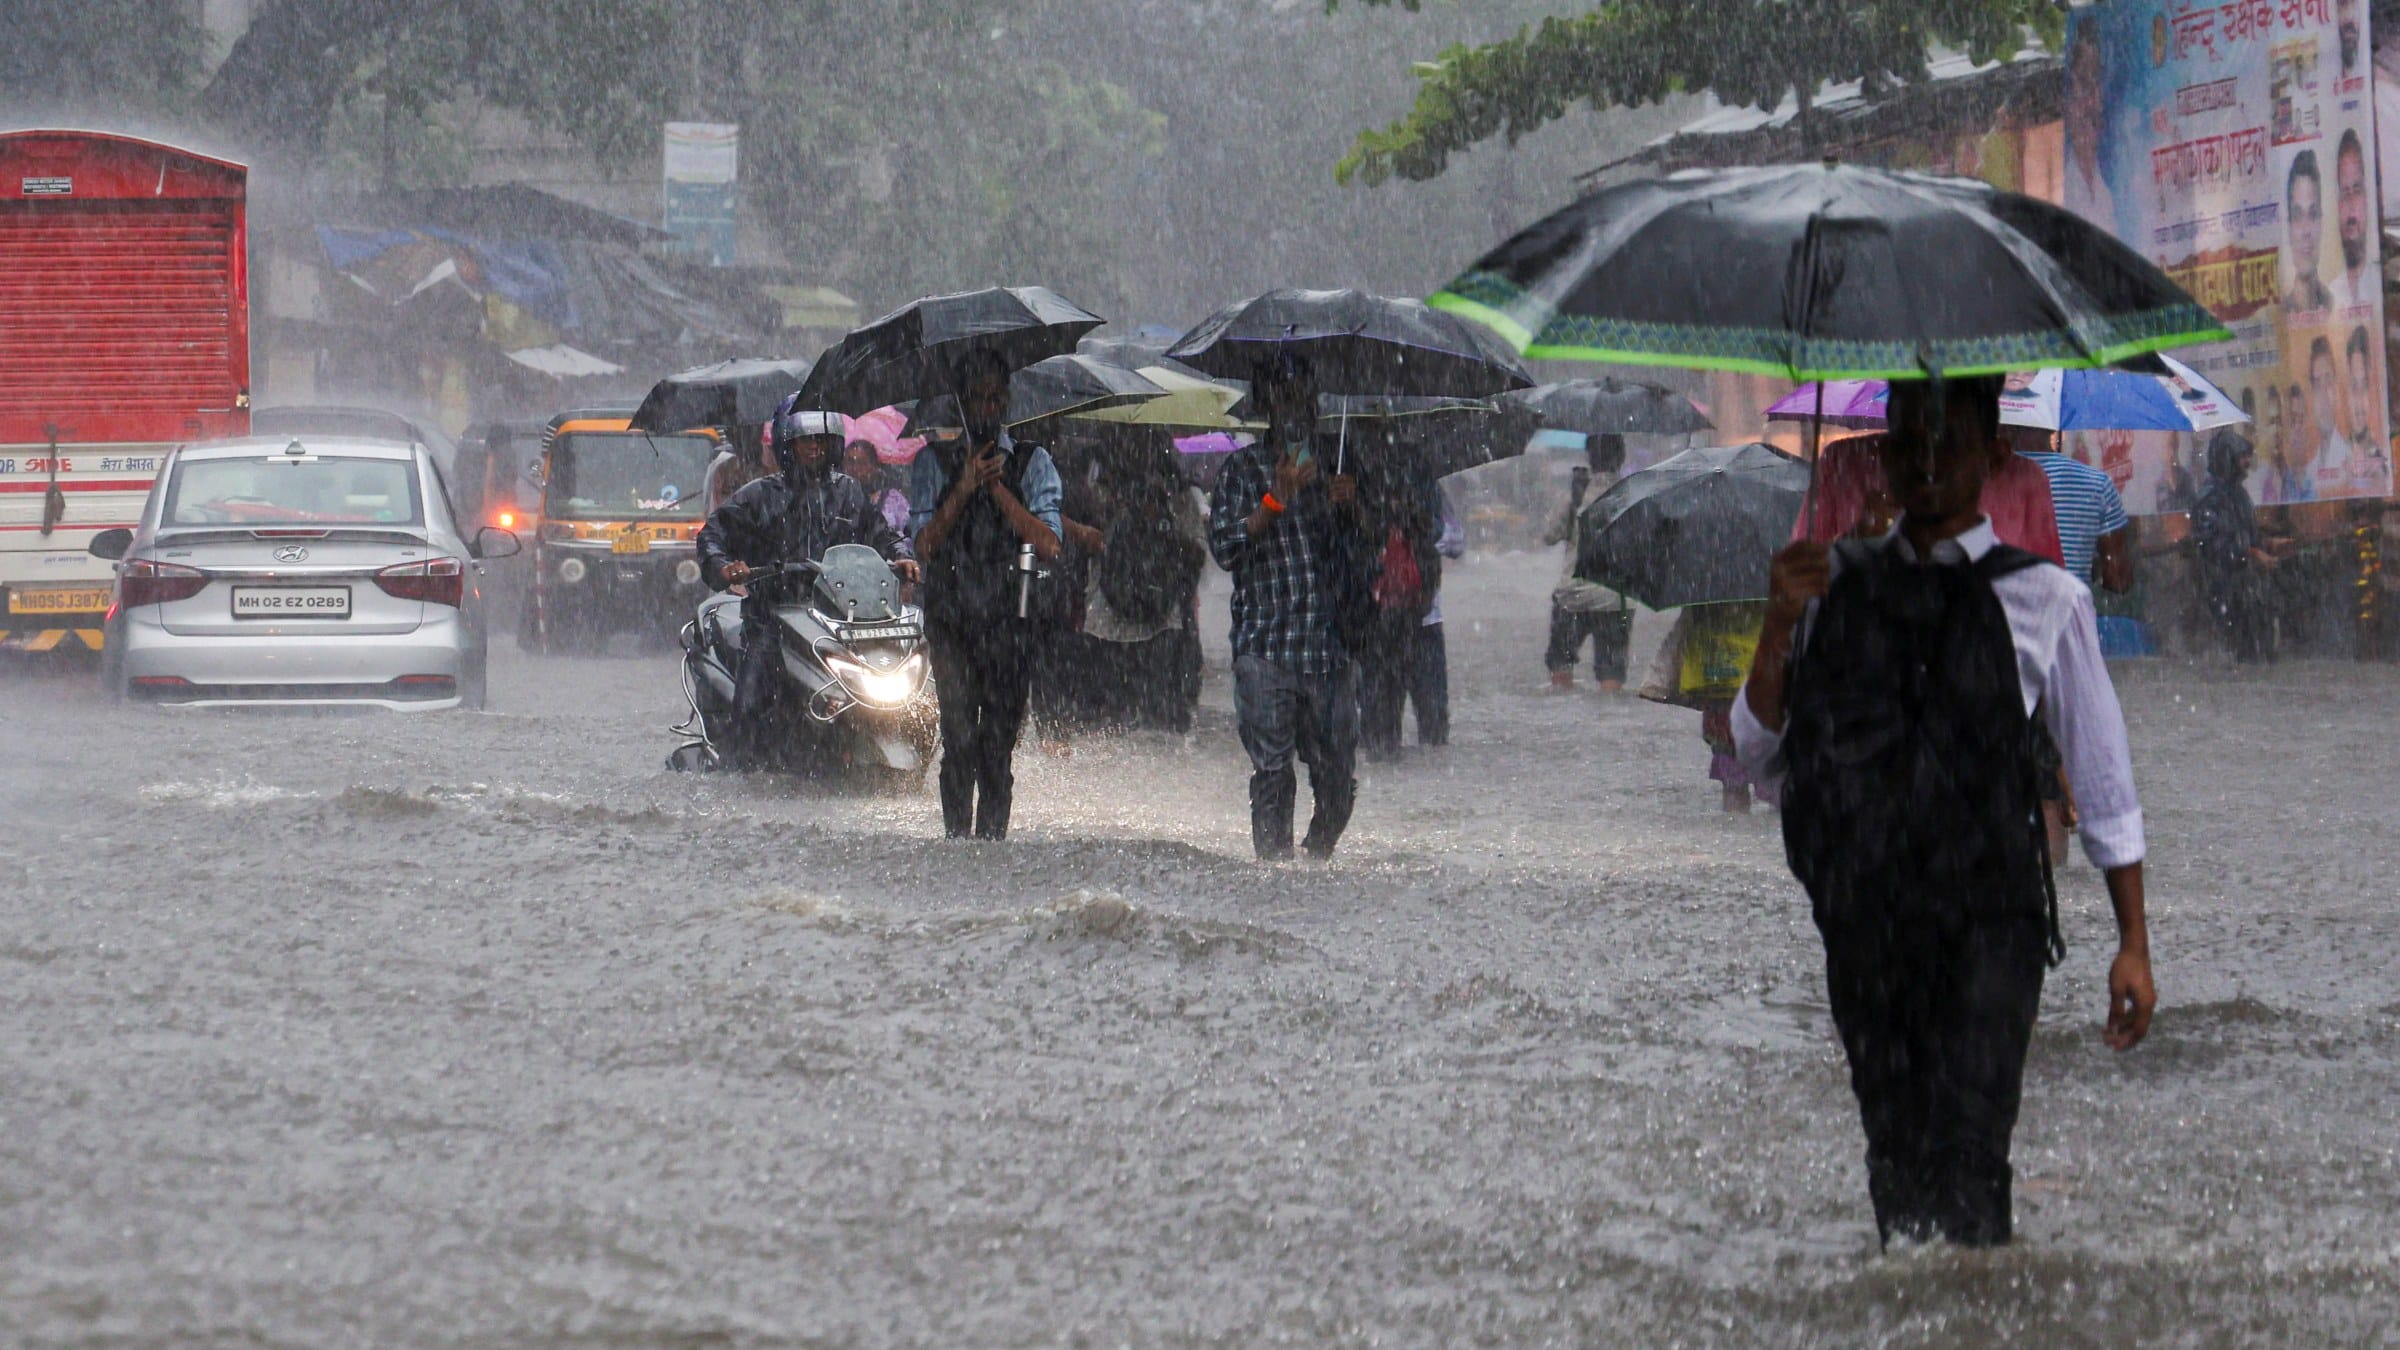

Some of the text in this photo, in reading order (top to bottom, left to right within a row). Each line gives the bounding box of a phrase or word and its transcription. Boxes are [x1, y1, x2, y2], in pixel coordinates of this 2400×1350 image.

[2280, 0, 2331, 29] सना
[239, 597, 345, 608] MH 02 EZ 0289
